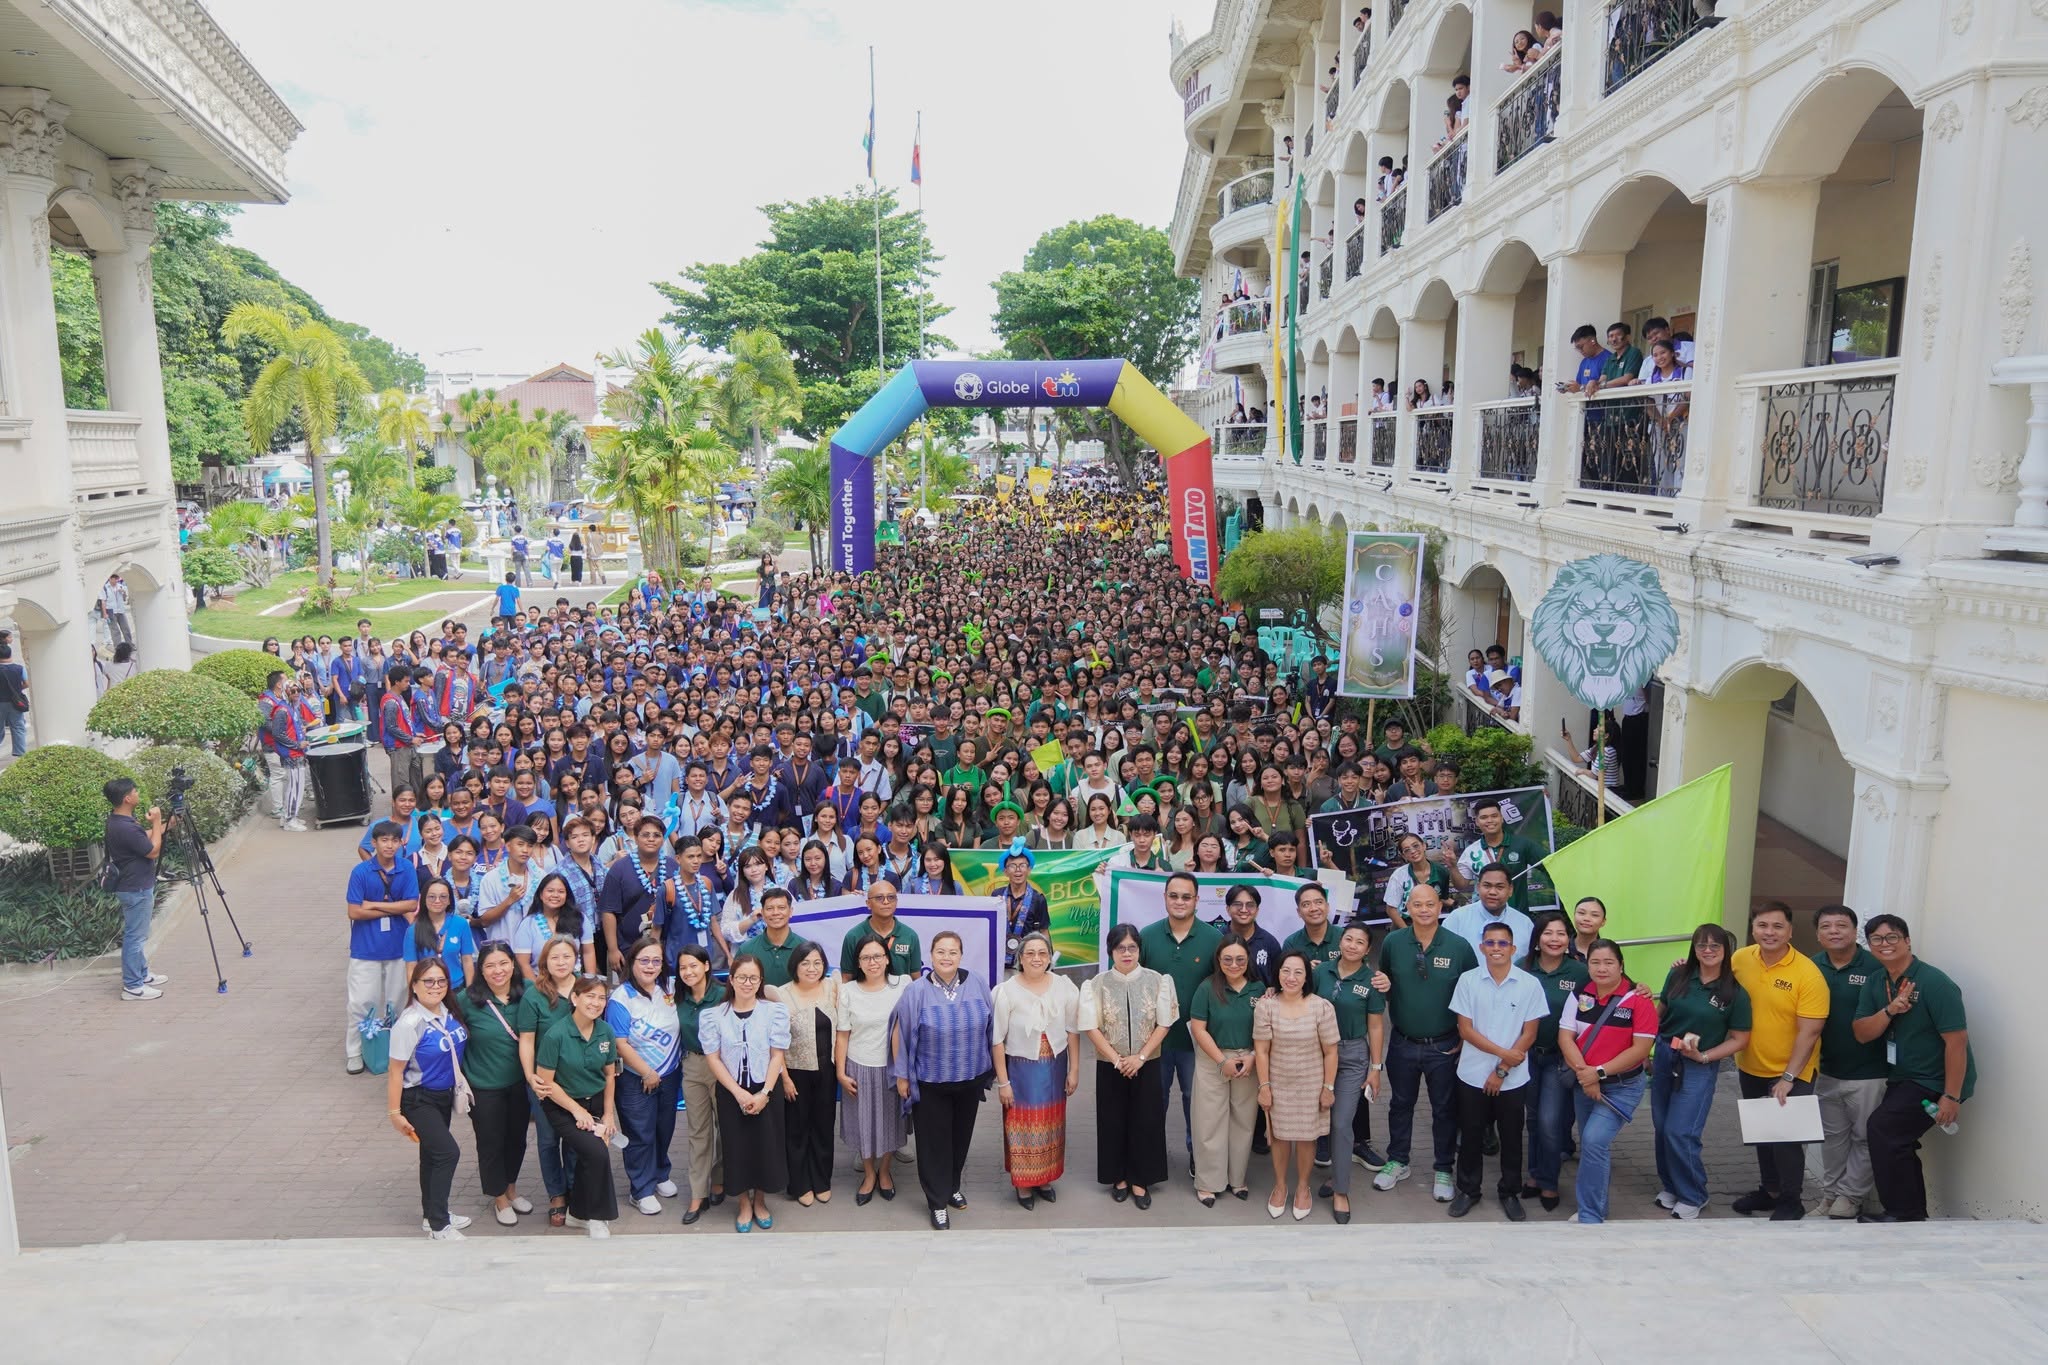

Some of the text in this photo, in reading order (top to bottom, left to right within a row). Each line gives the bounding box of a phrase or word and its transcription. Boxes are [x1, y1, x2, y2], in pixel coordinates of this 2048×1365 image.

[986, 381, 1030, 394] Globe
[1041, 376, 1080, 398] tm
[842, 478, 855, 541] Together
[1184, 488, 1210, 583] EAMTAYO
[895, 944, 910, 952] CSU
[1434, 957, 1451, 966] CSU
[1559, 980, 1576, 990] CSU
[1849, 974, 1867, 984] CSU
[1352, 984, 1370, 996] CSU
[631, 1016, 673, 1047] CTED
